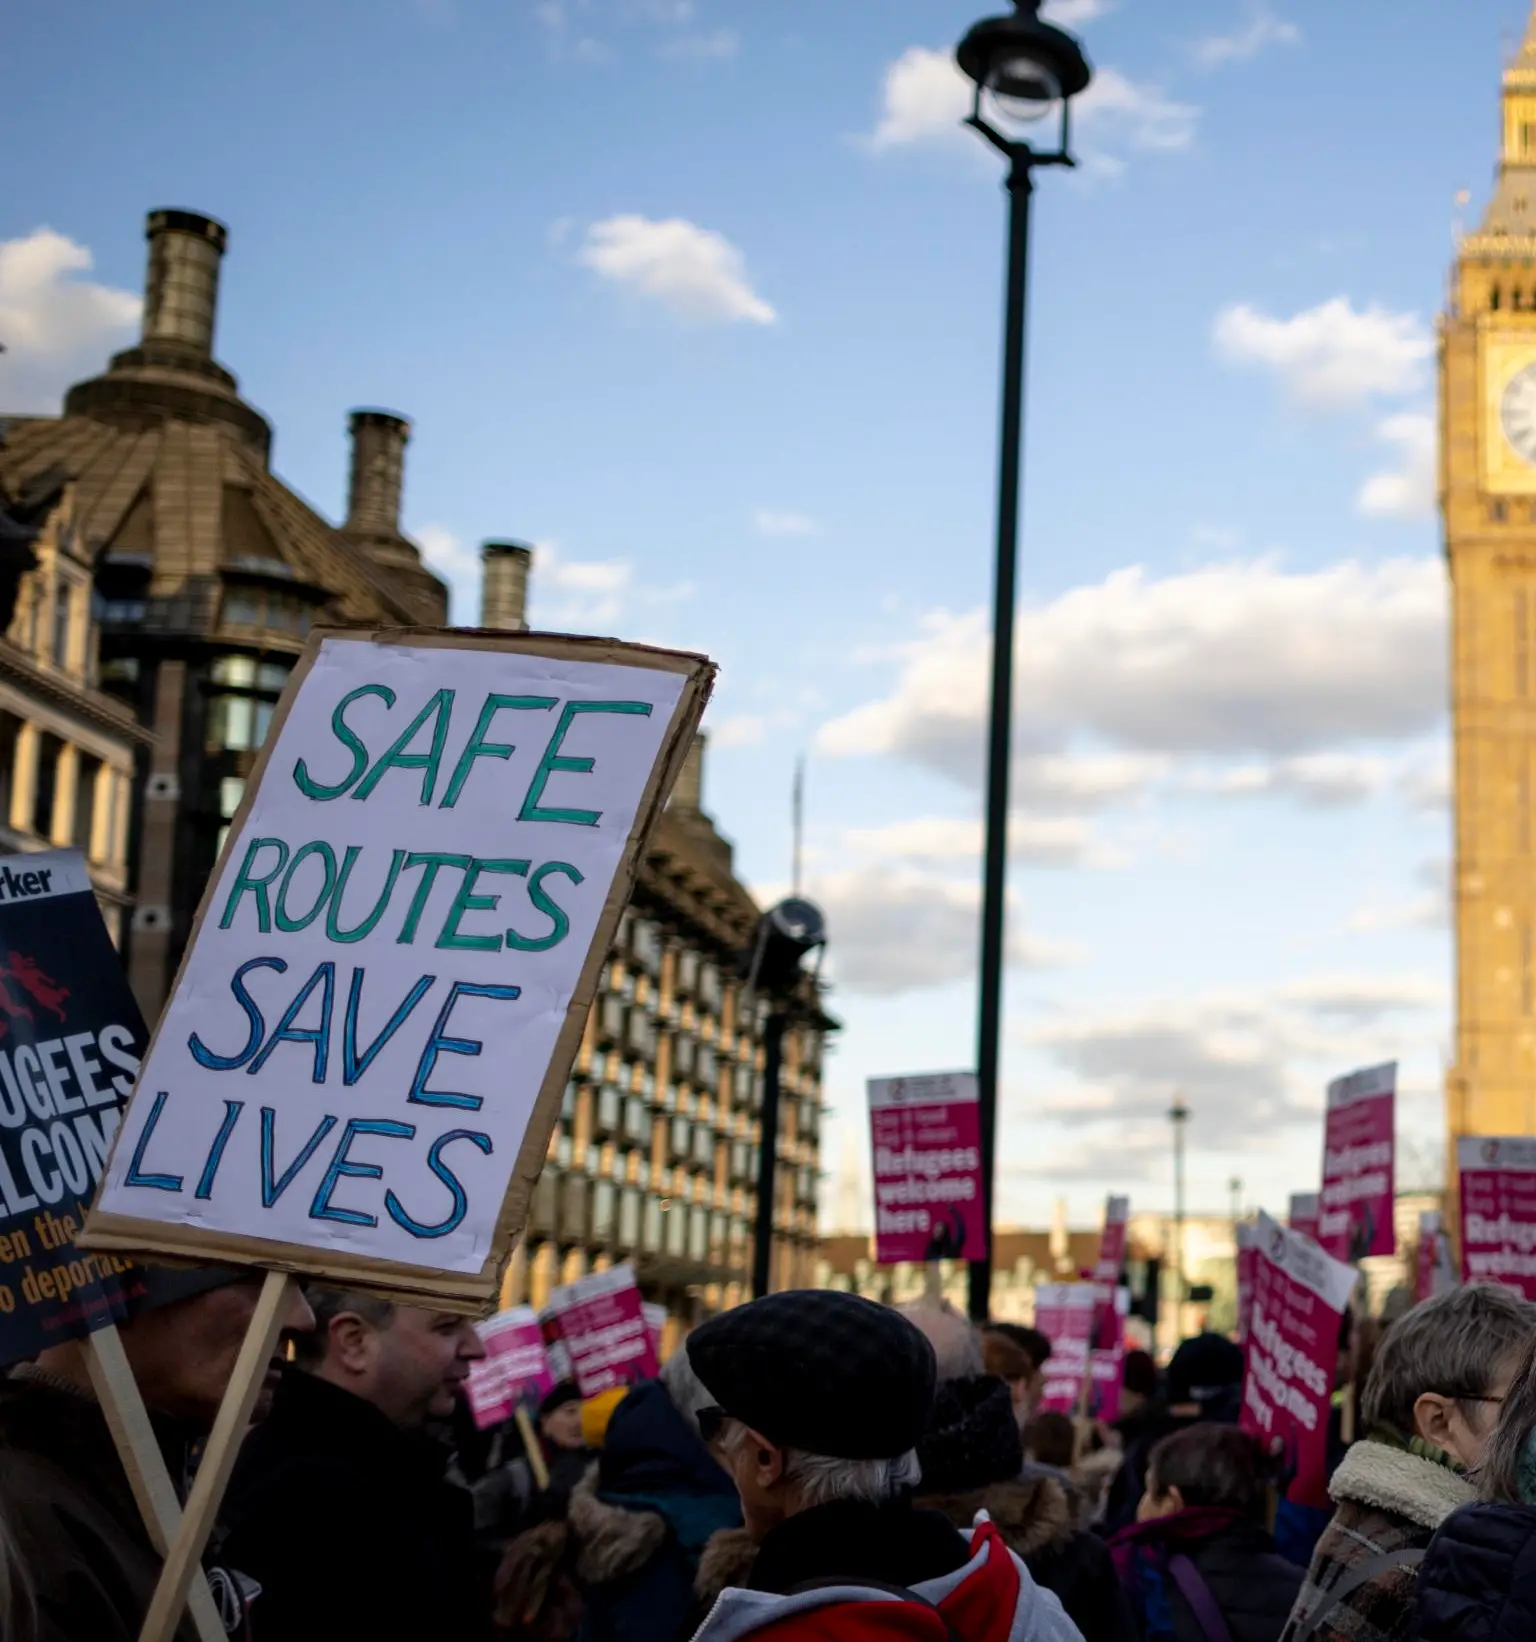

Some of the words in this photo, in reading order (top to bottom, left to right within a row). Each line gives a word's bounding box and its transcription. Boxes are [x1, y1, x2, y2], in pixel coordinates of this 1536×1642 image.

[292, 684, 653, 826] SAFE
[219, 837, 585, 952] ROUTES
[187, 956, 522, 1111] SAVE
[34, 1211, 78, 1250] the
[123, 1091, 493, 1239] LIVES
